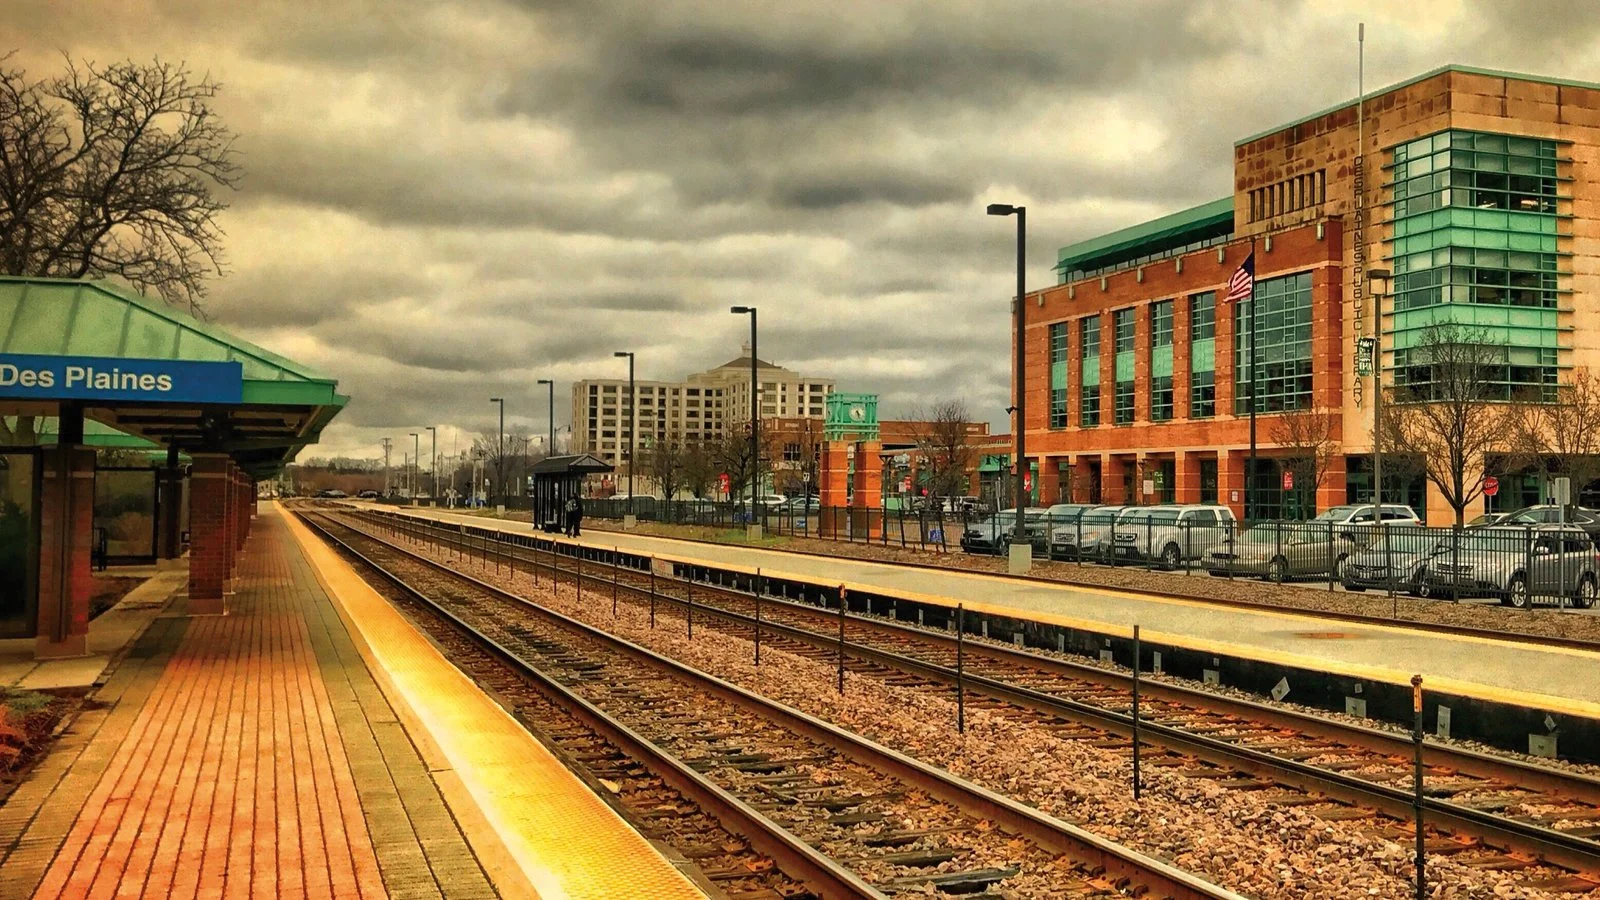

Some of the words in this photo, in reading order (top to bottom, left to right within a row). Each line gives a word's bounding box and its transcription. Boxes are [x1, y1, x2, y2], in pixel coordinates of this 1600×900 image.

[1353, 266, 1363, 331] PUBLIC
[0, 363, 55, 387] Des
[66, 366, 173, 392] Plaines
